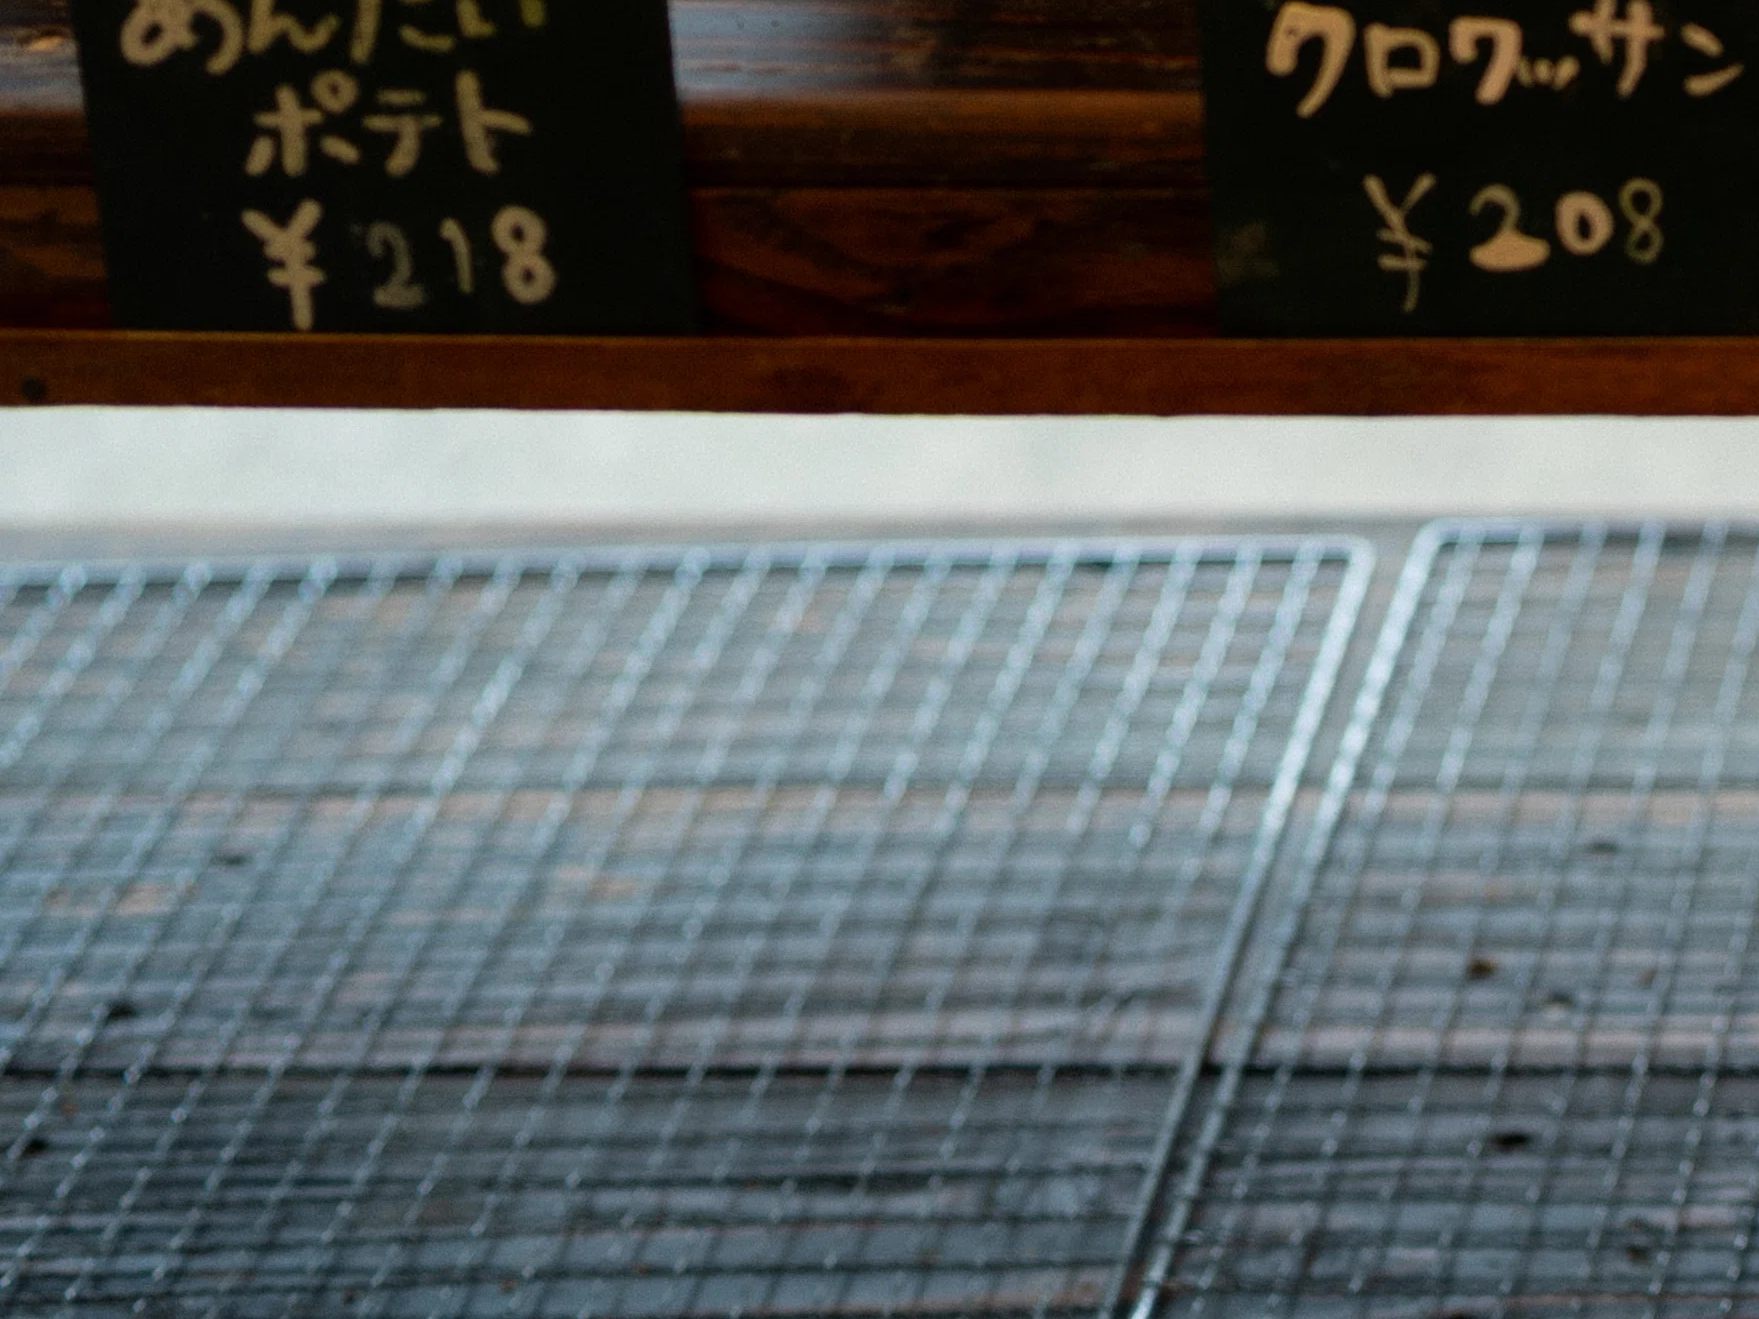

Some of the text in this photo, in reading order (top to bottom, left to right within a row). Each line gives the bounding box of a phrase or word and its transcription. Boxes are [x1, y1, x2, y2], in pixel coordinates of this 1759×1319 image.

[245, 69, 532, 175] ポテト
[241, 199, 556, 331] ¥218
[1362, 173, 1663, 313] ¥208
